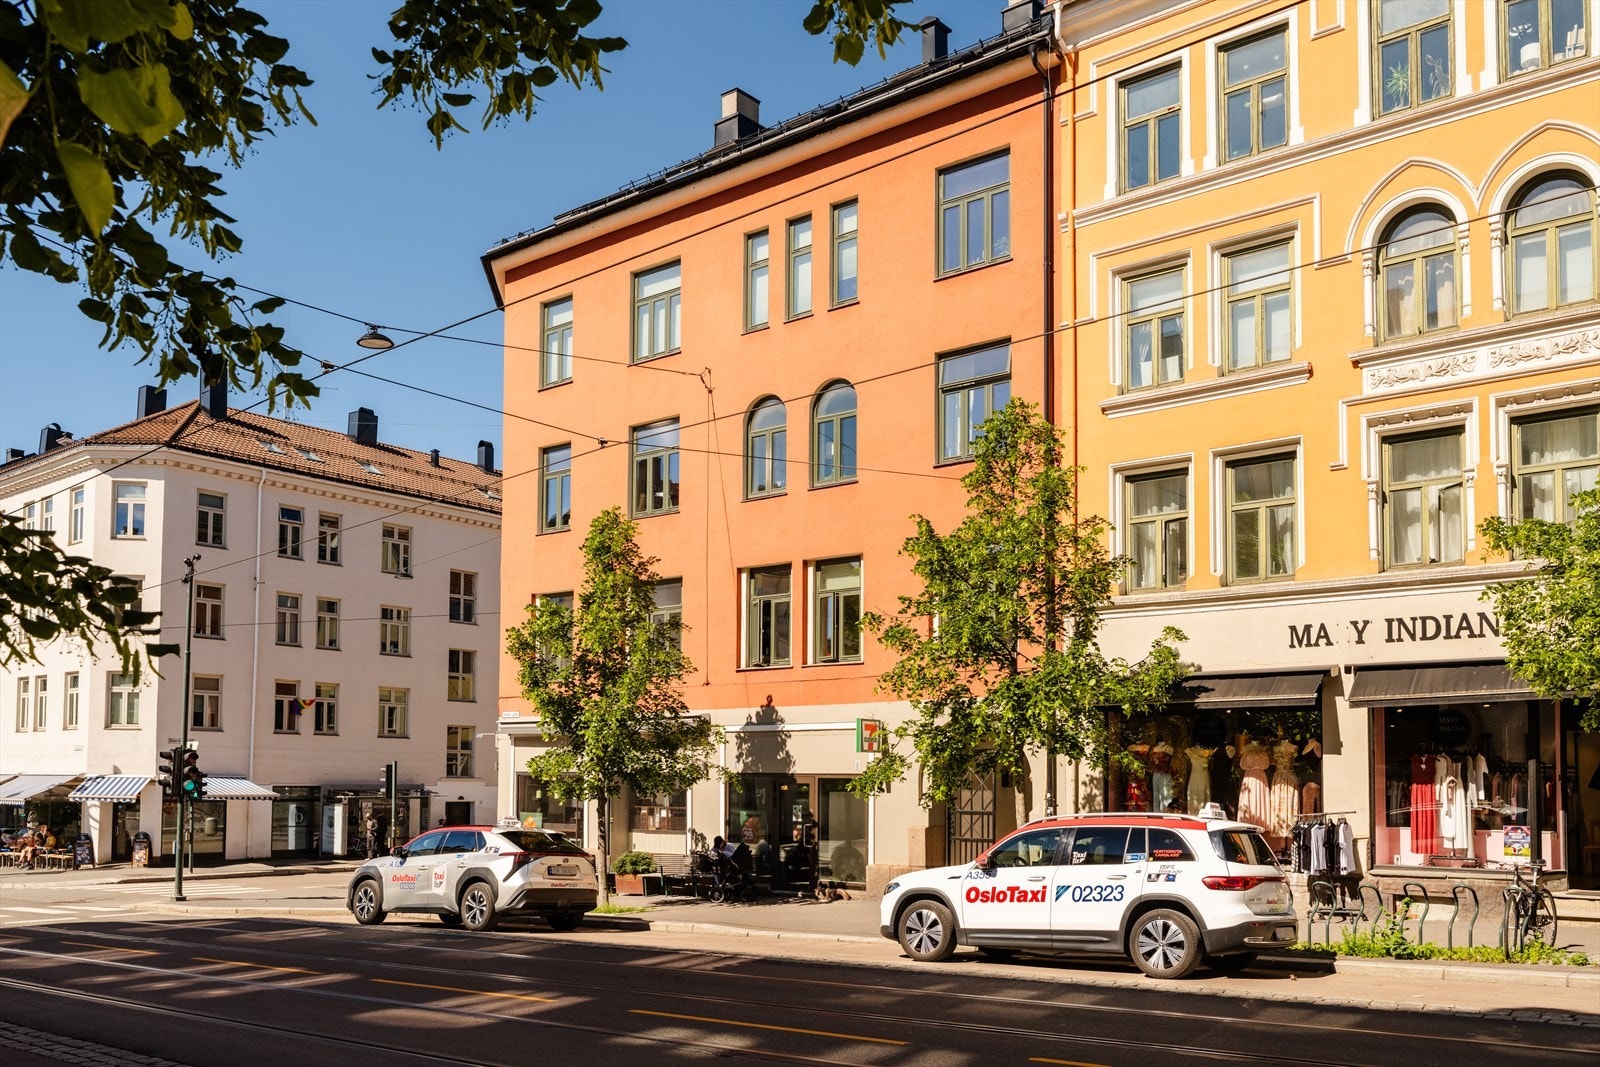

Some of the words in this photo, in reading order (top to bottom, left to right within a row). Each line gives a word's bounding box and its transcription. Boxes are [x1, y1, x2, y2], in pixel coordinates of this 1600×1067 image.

[1384, 611, 1509, 643] INDIAN
[743, 830, 753, 840] 29
[392, 874, 417, 882] OsloTaxi
[434, 871, 445, 880] Taxi
[965, 870, 992, 880] A355
[965, 885, 1047, 903] OsloTaxi
[1071, 885, 1124, 902] 02323
